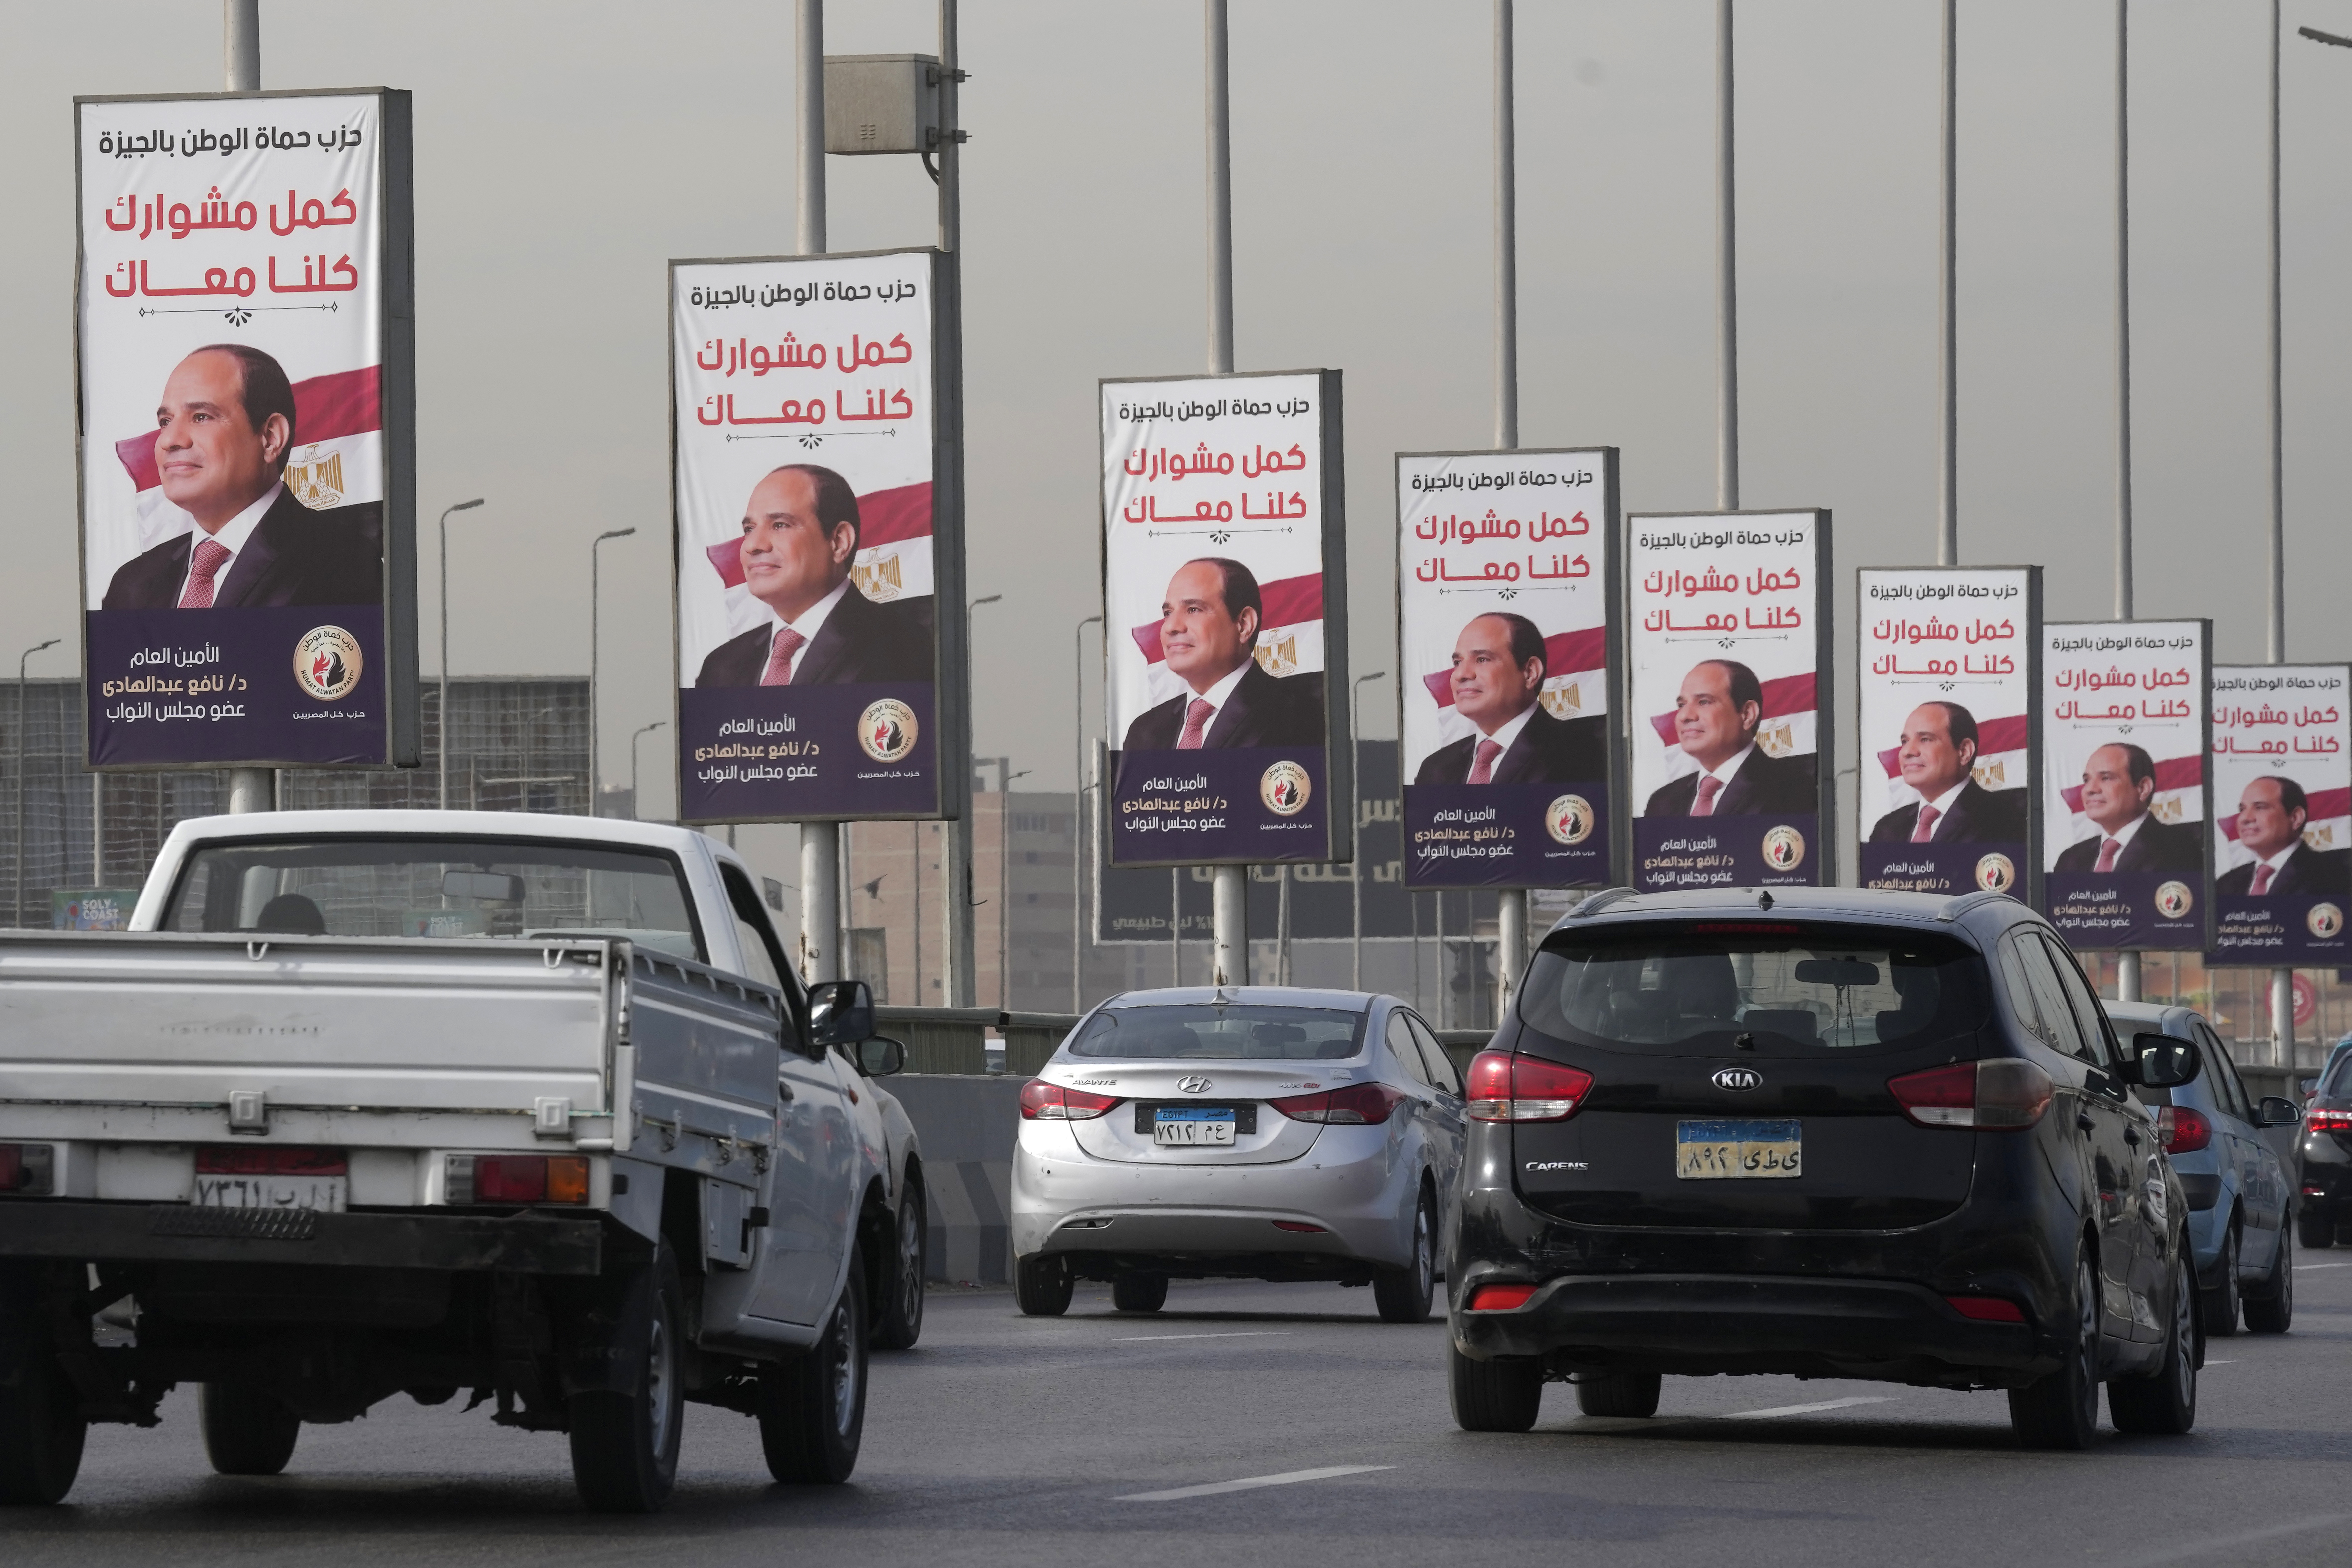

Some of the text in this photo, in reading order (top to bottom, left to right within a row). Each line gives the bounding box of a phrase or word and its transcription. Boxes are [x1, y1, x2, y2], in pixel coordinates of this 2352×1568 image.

[99, 124, 362, 160] حزب حماة الوطن بالجيزة
[105, 185, 357, 240] كمل مشوارك
[105, 253, 358, 298] كلنا معاك
[691, 279, 916, 310] حزب حماة الوطن بالجيزة
[696, 331, 912, 377] كمل مشوارك
[696, 387, 913, 426] كلنا معاك
[1119, 396, 1309, 424] حزب حماة الوطن بالجيزة
[1123, 442, 1306, 482] كمل مشوارك
[1411, 469, 1592, 493] حزب حماة الوطن بالجيزة
[1241, 491, 1307, 520] كلنا
[1415, 509, 1589, 545] كمل مشوارك
[1640, 529, 1803, 551] حزب حماة الوطن بالجيزة
[1528, 553, 1590, 579] كلنا
[1644, 565, 1800, 598] كمل مشوارك
[1870, 584, 2018, 601] حزب حماة الوطن بالجيزة
[1745, 605, 1801, 630] كلنا
[1873, 615, 2014, 645] كمل مشوارك
[303, 632, 322, 652] الوطن
[342, 637, 354, 652] حزب
[2052, 636, 2192, 653] حزب حماة الوطن بالجيزة
[129, 641, 219, 669] الأمين العام
[1964, 653, 2015, 675] كلنا
[187, 674, 224, 696] نافع
[300, 669, 356, 696] HUMAT ALWATAN PARTY
[2055, 665, 2190, 692] كمل مشوارك
[105, 700, 246, 724] عضو مجلس النواب
[292, 710, 329, 720] المصريين
[329, 710, 344, 719] كل
[2141, 698, 2190, 719] كلنا
[718, 713, 795, 737] الأمين العام
[768, 741, 800, 760] نافع
[864, 736, 912, 759] HUMAT ALWATAN PARTY
[698, 763, 819, 784] عضو مجلس النواب
[1142, 773, 1207, 793] الأمين العام
[1183, 797, 1211, 813] نافع
[1433, 805, 1495, 823] الأمين العام
[1125, 816, 1226, 833] عضو مجلس النواب
[1473, 827, 1499, 842] نافع
[82, 899, 111, 910] SOLY
[83, 909, 119, 920] COAST
[1721, 1073, 1755, 1087] KIA
[1162, 1110, 1189, 1119] EGYPT
[1525, 1161, 1590, 1171] CARENS
